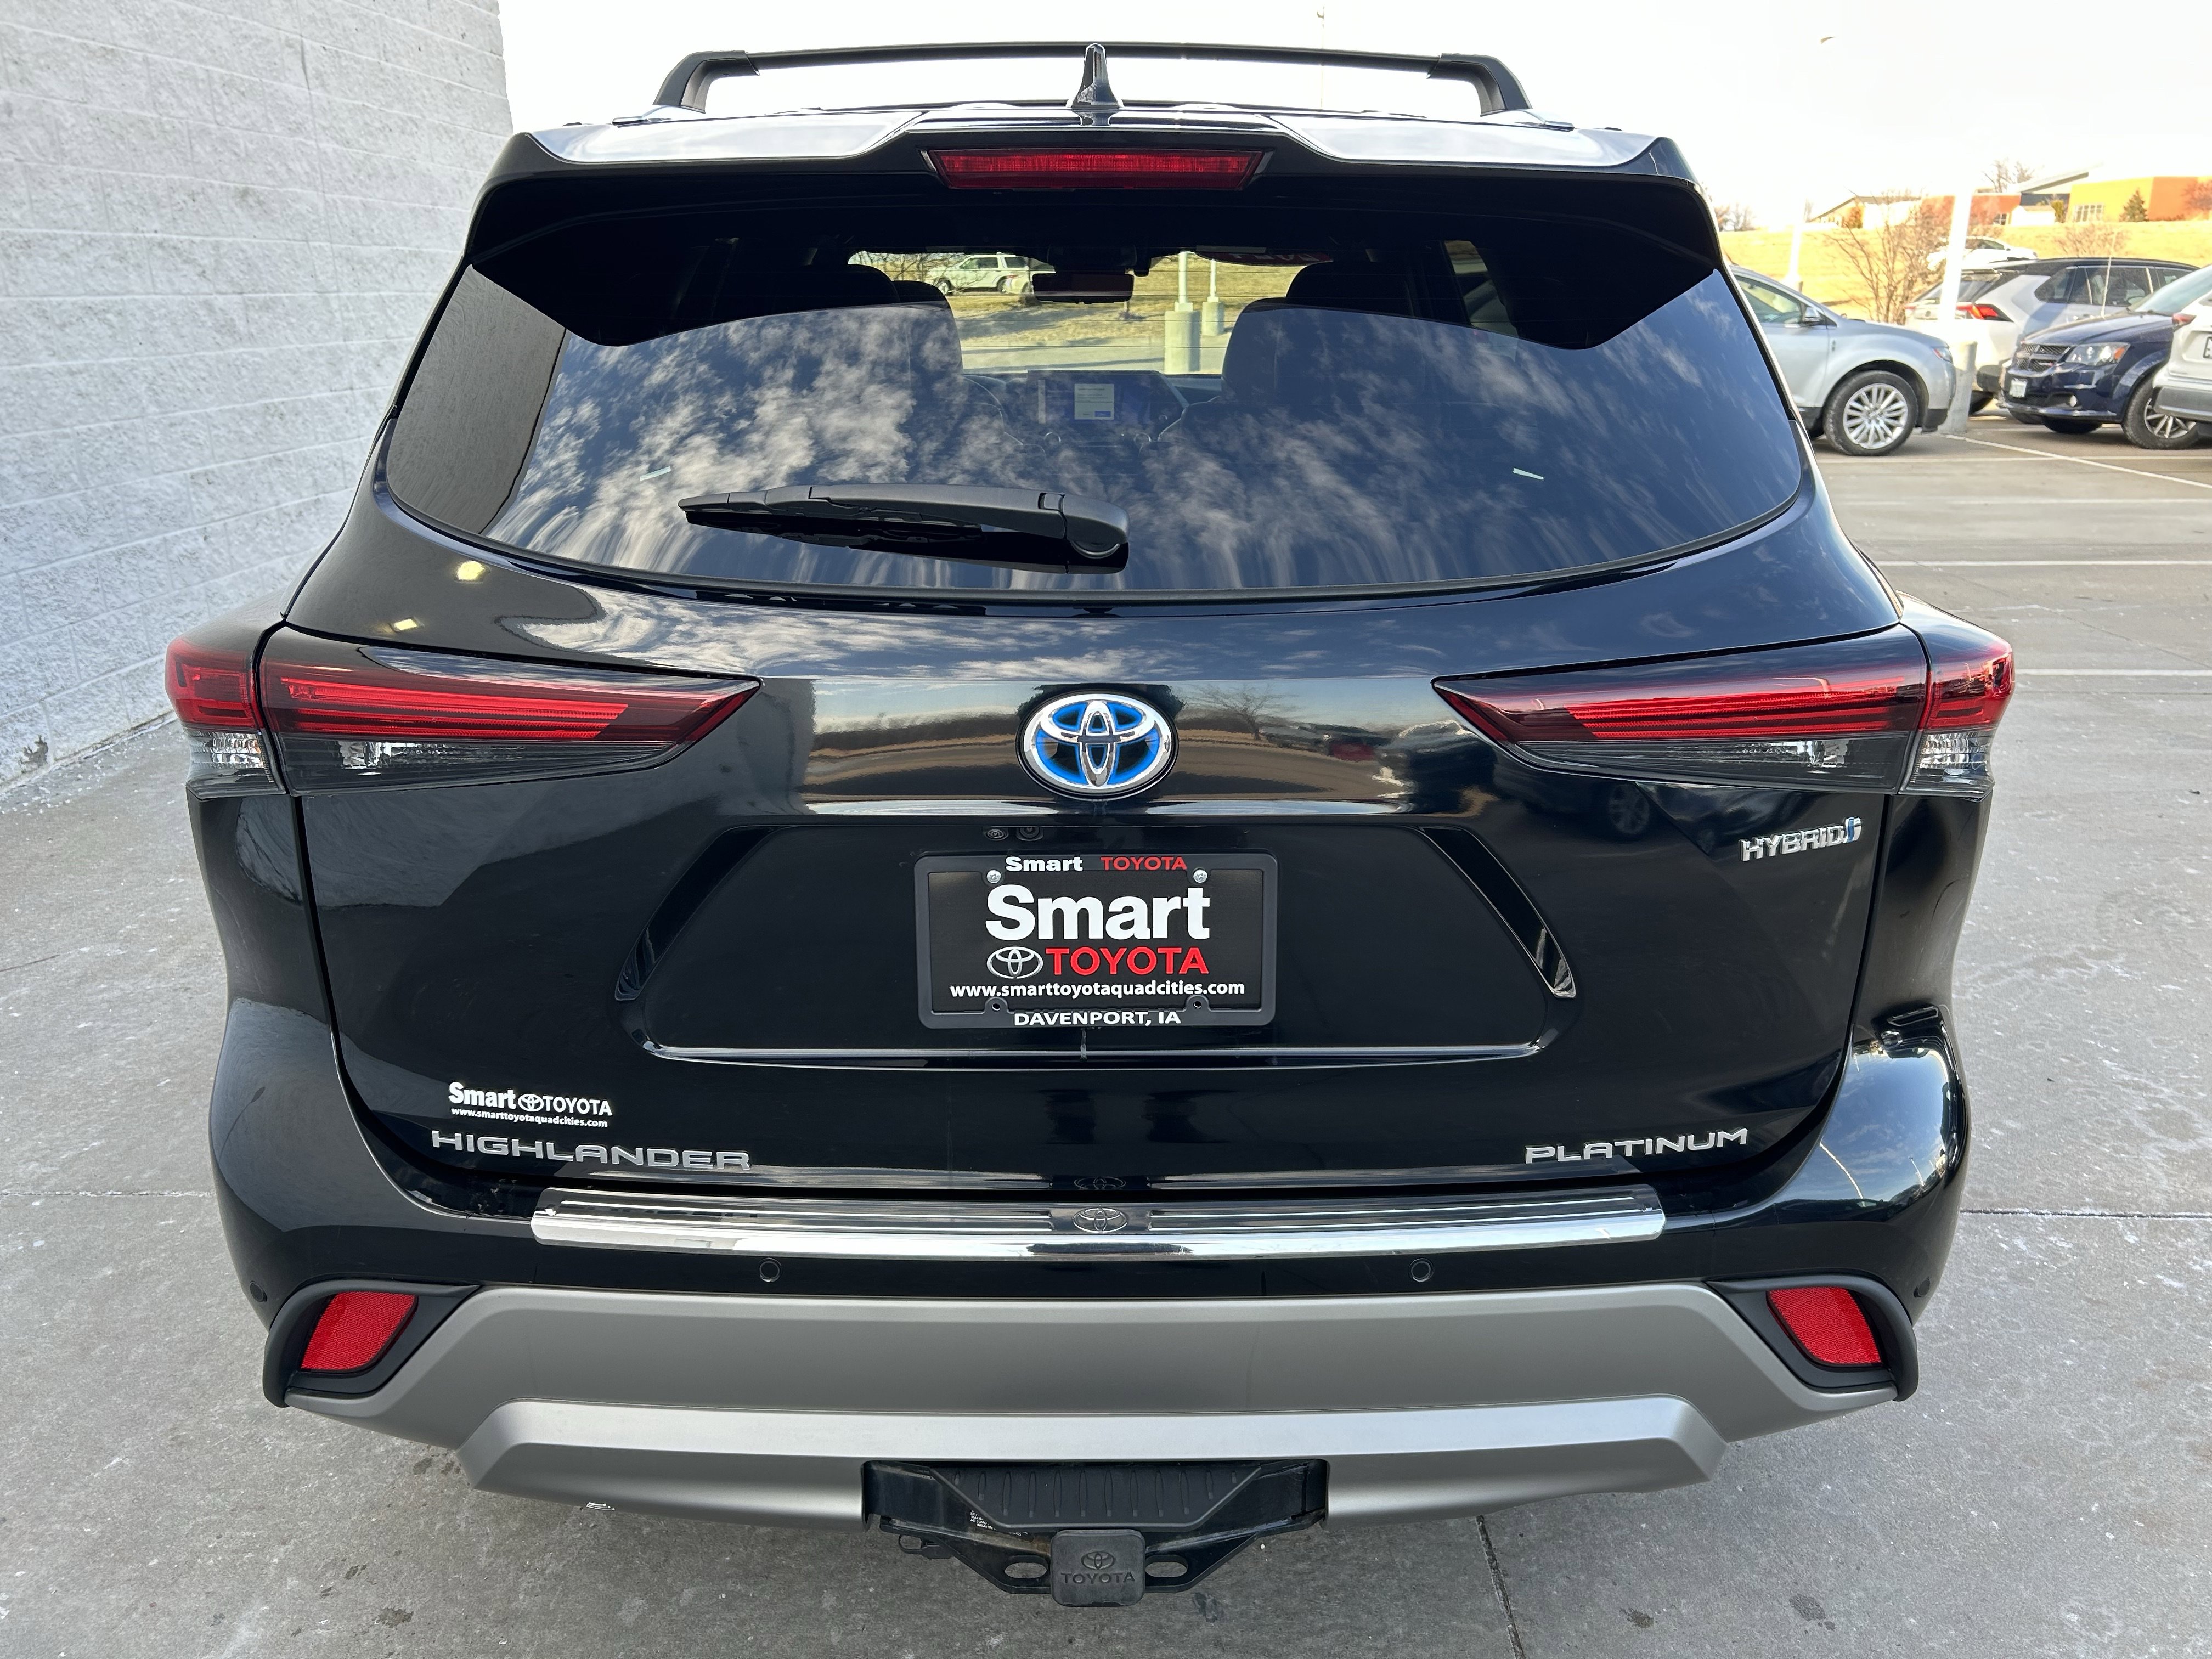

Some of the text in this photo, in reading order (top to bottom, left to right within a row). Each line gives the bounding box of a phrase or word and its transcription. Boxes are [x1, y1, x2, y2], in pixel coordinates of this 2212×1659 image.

[1739, 825, 1844, 862] HYBRID
[1005, 856, 1187, 872] Smart TOYOTA
[985, 884, 1210, 941] Smart
[1045, 946, 1209, 976] TOYOTA
[950, 980, 1245, 999] www.smarttoyotaquadcities.com
[1014, 1010, 1181, 1026] DAVENPORT, IA
[448, 1081, 613, 1116] Smart TOYOTA
[451, 1108, 608, 1128] www.smarttoyotaquadcities.com
[431, 1130, 751, 1170] HIGHLANDER
[1525, 1128, 1748, 1164] PLATINUM
[1060, 1571, 1136, 1584] TOYOTA
